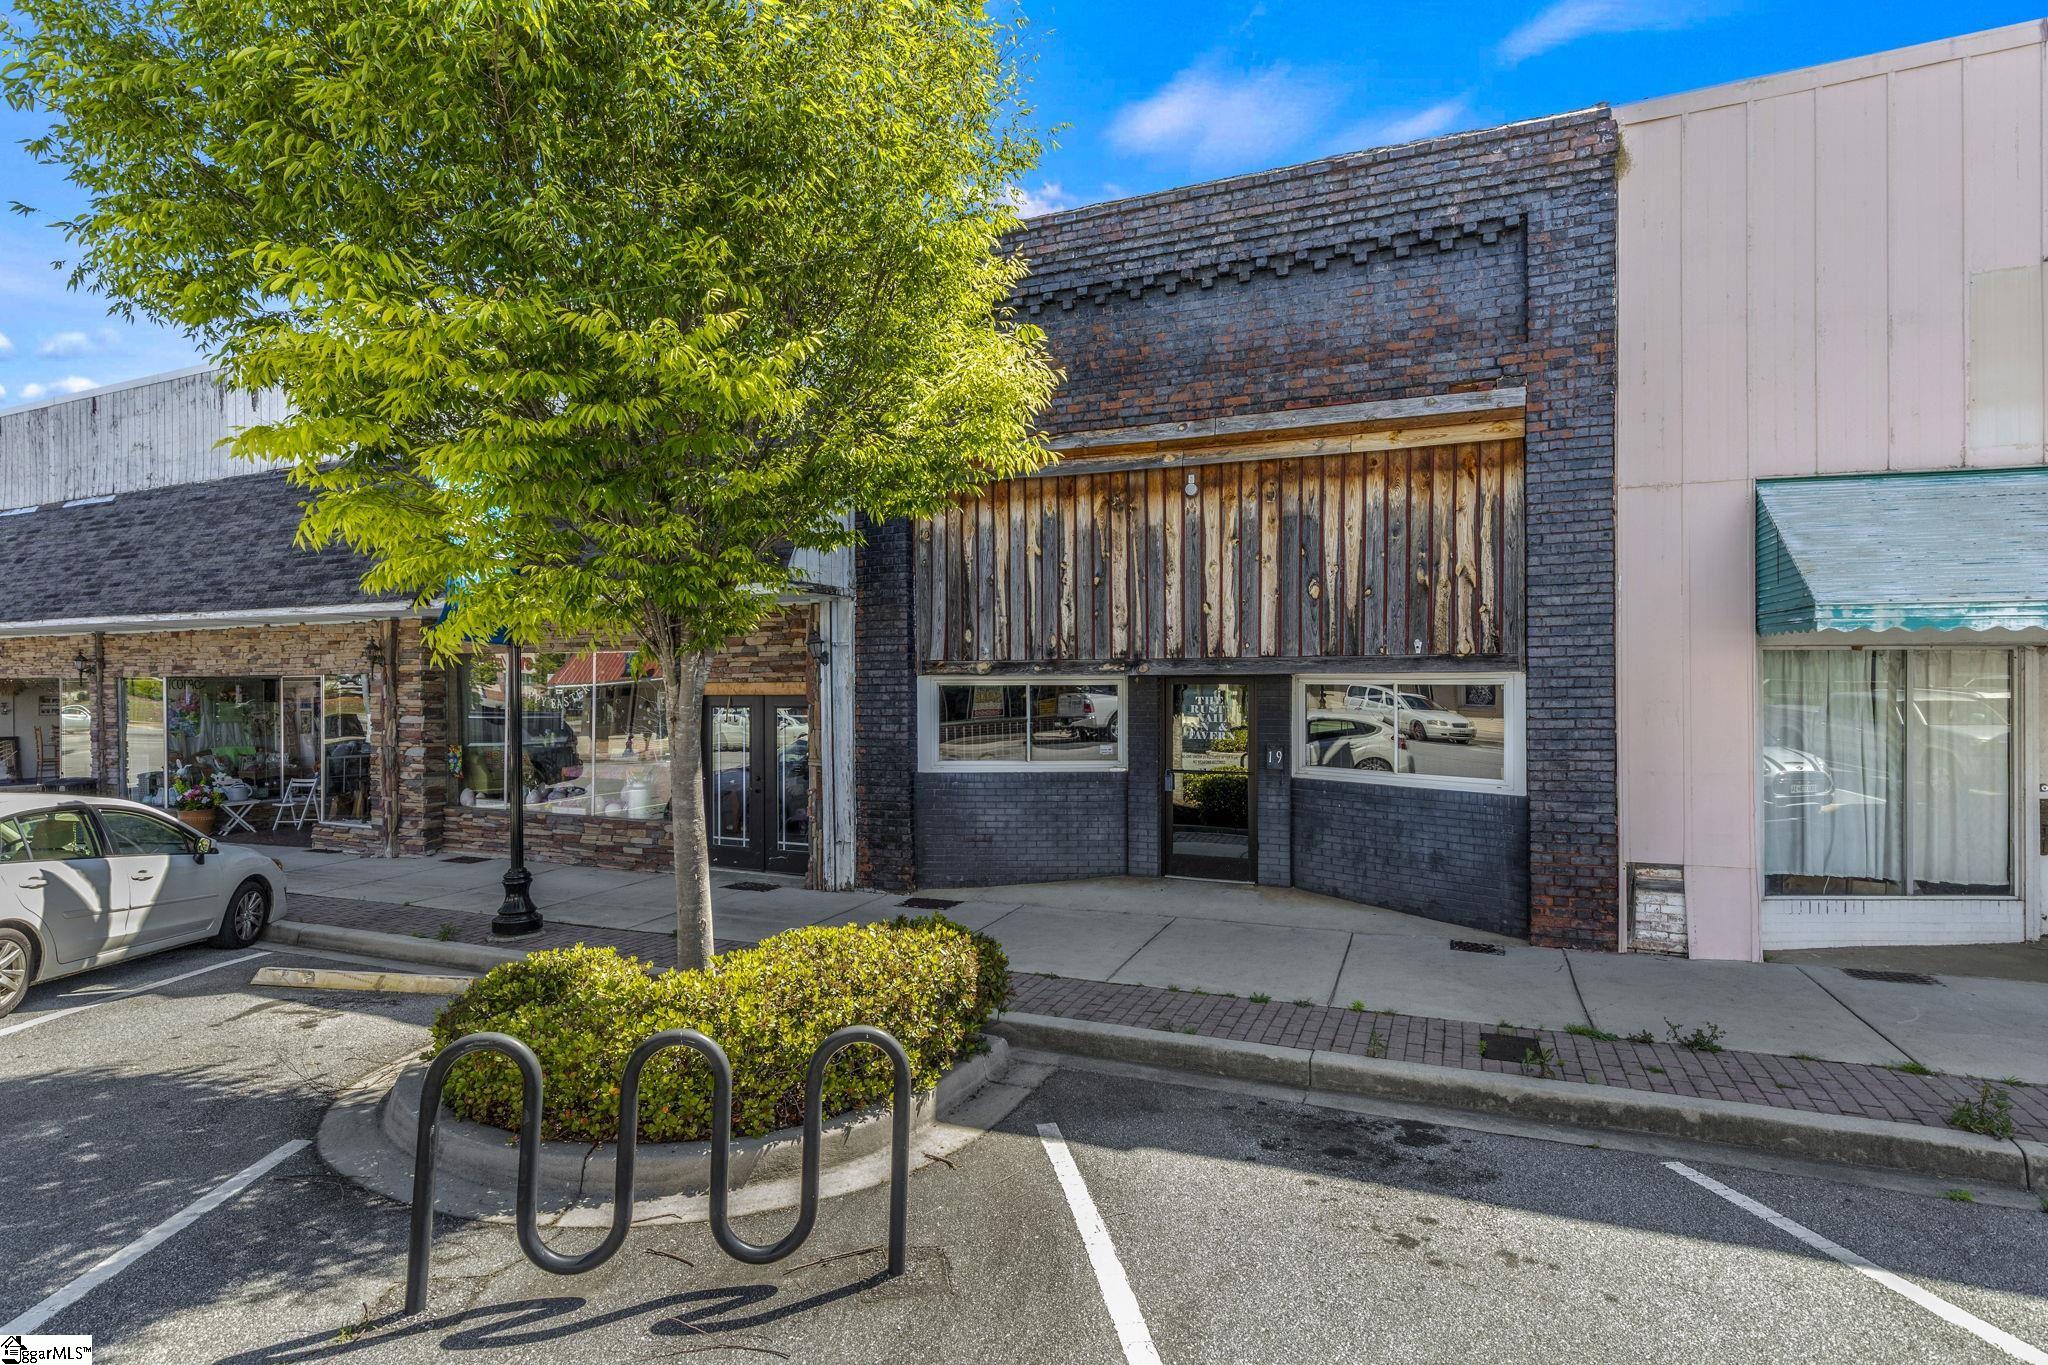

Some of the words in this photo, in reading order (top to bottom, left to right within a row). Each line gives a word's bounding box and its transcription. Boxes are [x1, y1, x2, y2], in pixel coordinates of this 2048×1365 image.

[1195, 696, 1224, 705] THE
[1190, 704, 1228, 713] RUST
[1218, 722, 1229, 731] &
[1189, 731, 1235, 741] TAVERN
[1268, 750, 1283, 764] 19
